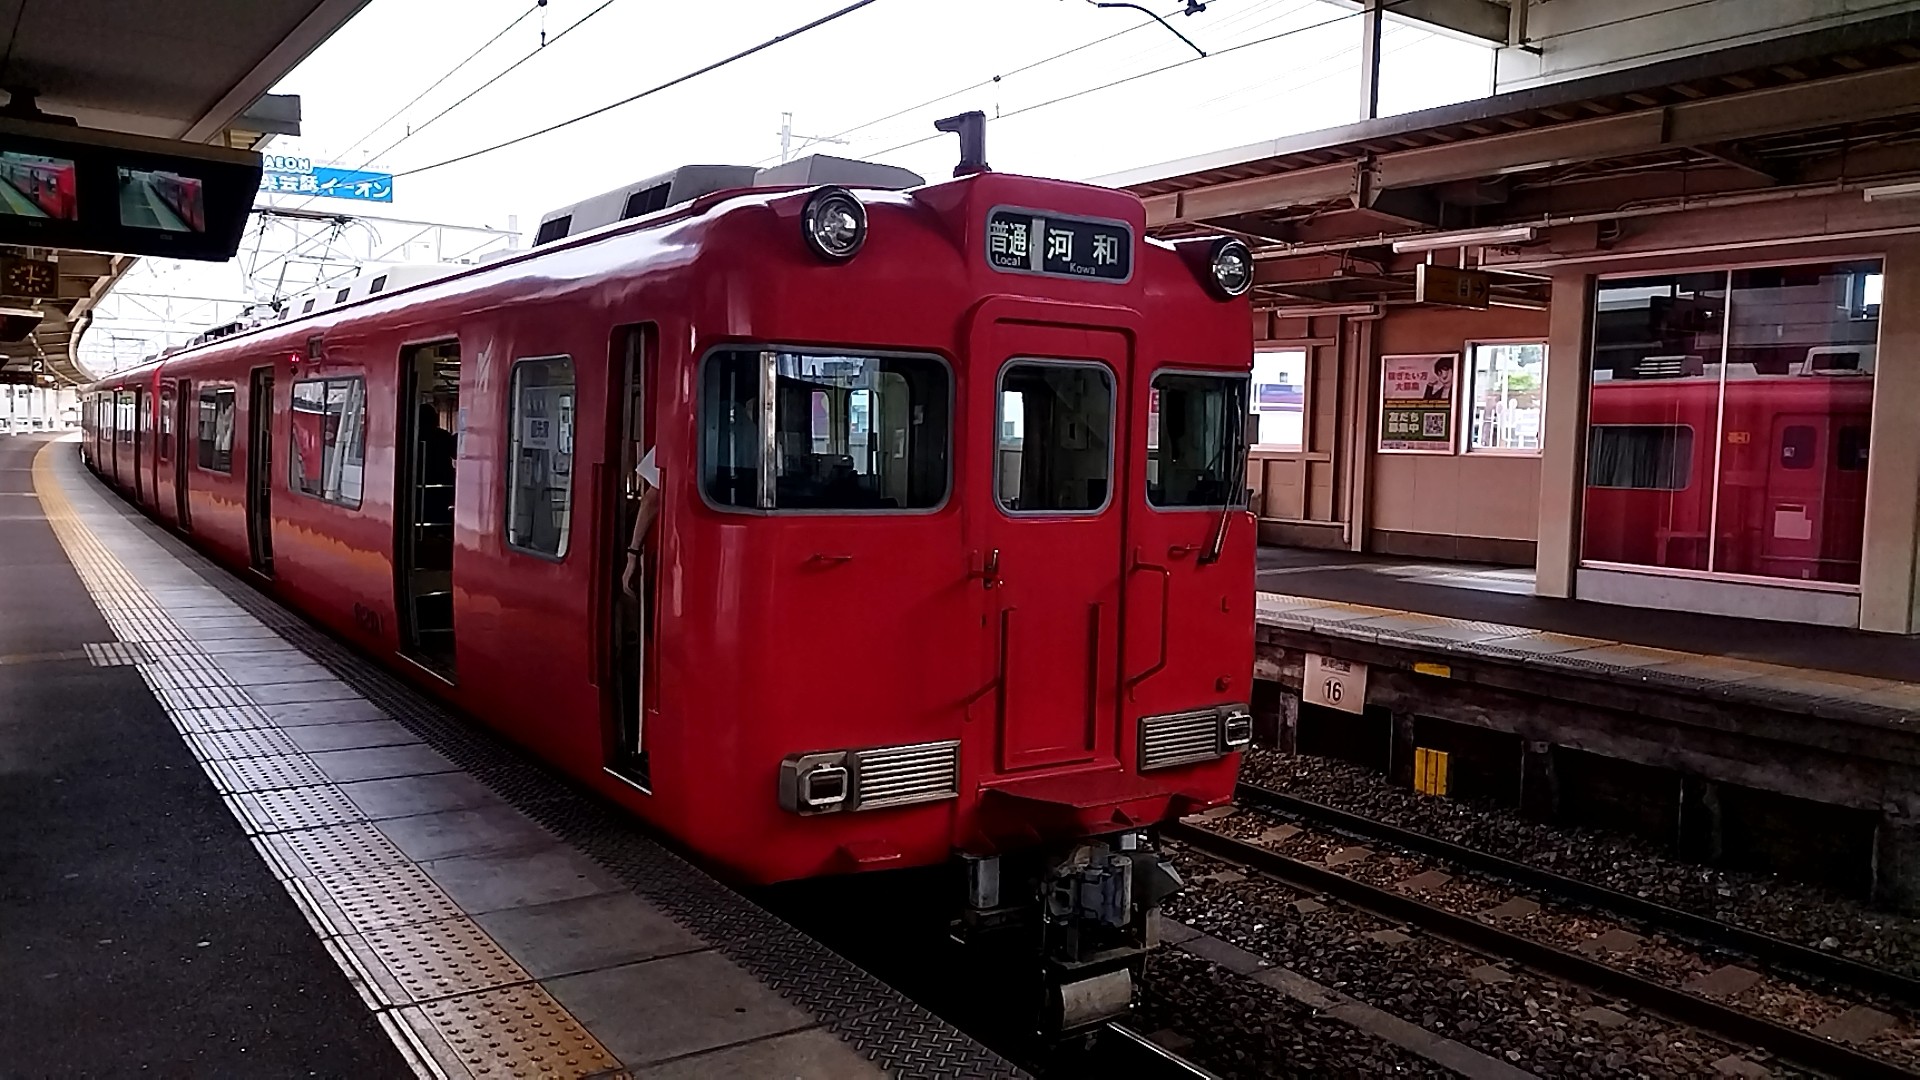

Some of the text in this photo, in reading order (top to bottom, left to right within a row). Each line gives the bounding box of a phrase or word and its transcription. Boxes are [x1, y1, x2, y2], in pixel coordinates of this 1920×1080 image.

[263, 155, 311, 170] AEON
[990, 220, 1027, 256] 普通
[1047, 228, 1119, 265] 河和
[995, 254, 1021, 266] Local
[1069, 262, 1096, 275] Kowa
[33, 361, 43, 371] 2
[1326, 680, 1342, 702] 16
